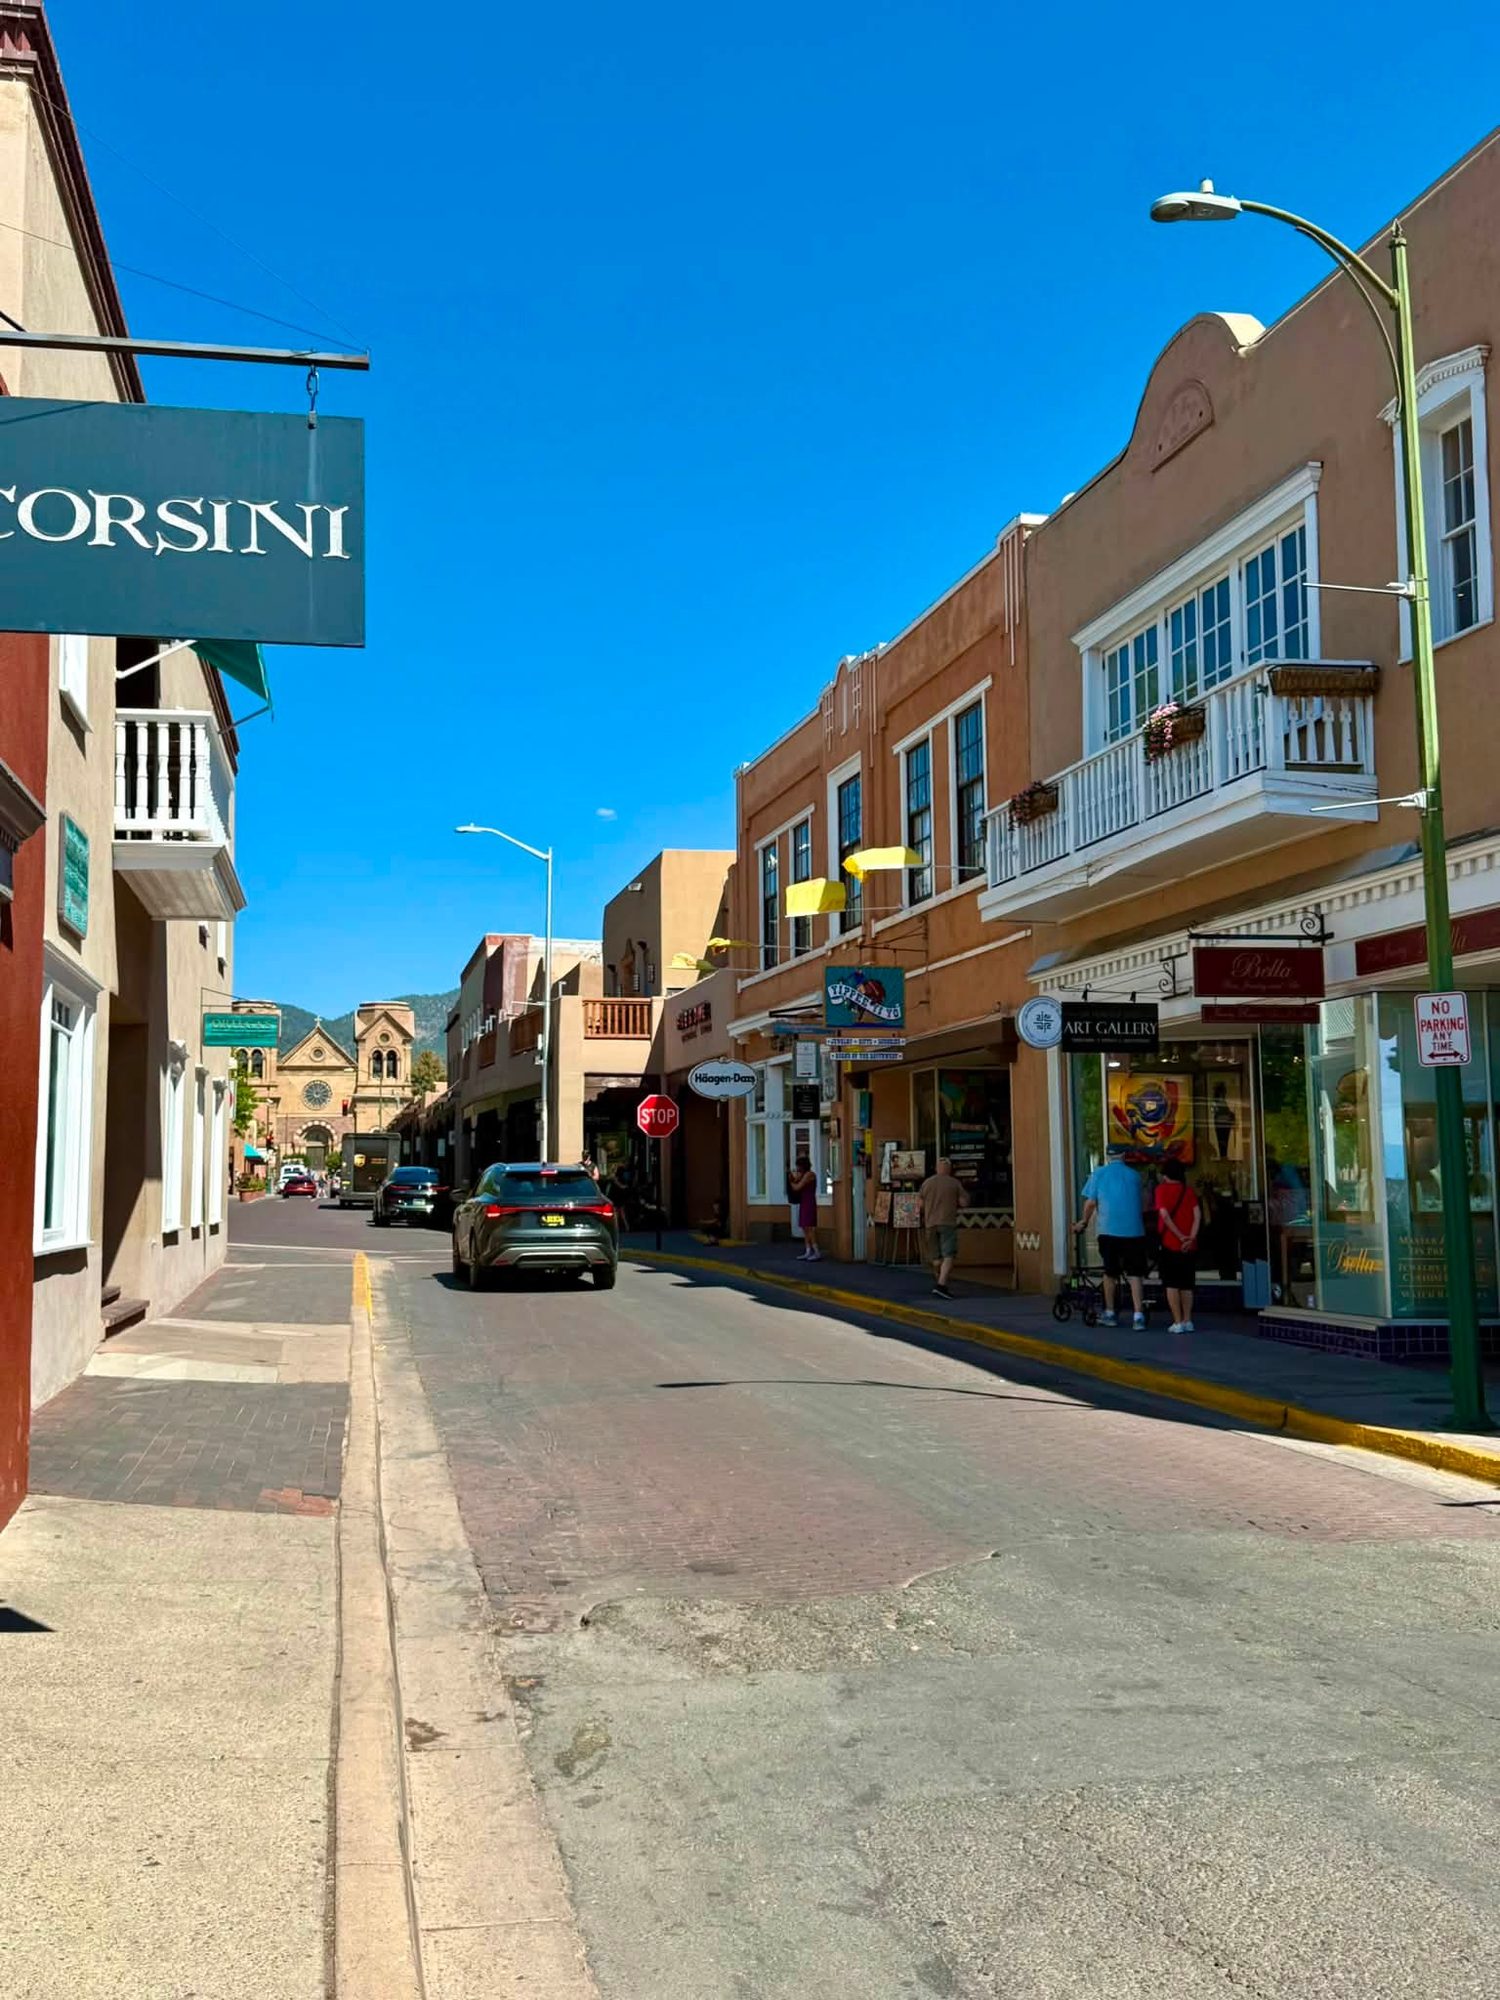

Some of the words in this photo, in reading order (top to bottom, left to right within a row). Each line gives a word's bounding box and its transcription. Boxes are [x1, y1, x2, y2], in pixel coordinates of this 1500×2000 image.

[1231, 952, 1291, 978] Bella
[830, 984, 869, 1008] YIPPEE
[1432, 1000, 1450, 1014] NO
[1063, 1021, 1091, 1035] ART
[1095, 1021, 1158, 1036] GALLERY
[1420, 1017, 1464, 1032] PARKING
[1432, 1031, 1452, 1040] ANY
[1432, 1041, 1454, 1051] TIME
[695, 1073, 755, 1085] Häagen-Dazs
[641, 1108, 676, 1124] STOP
